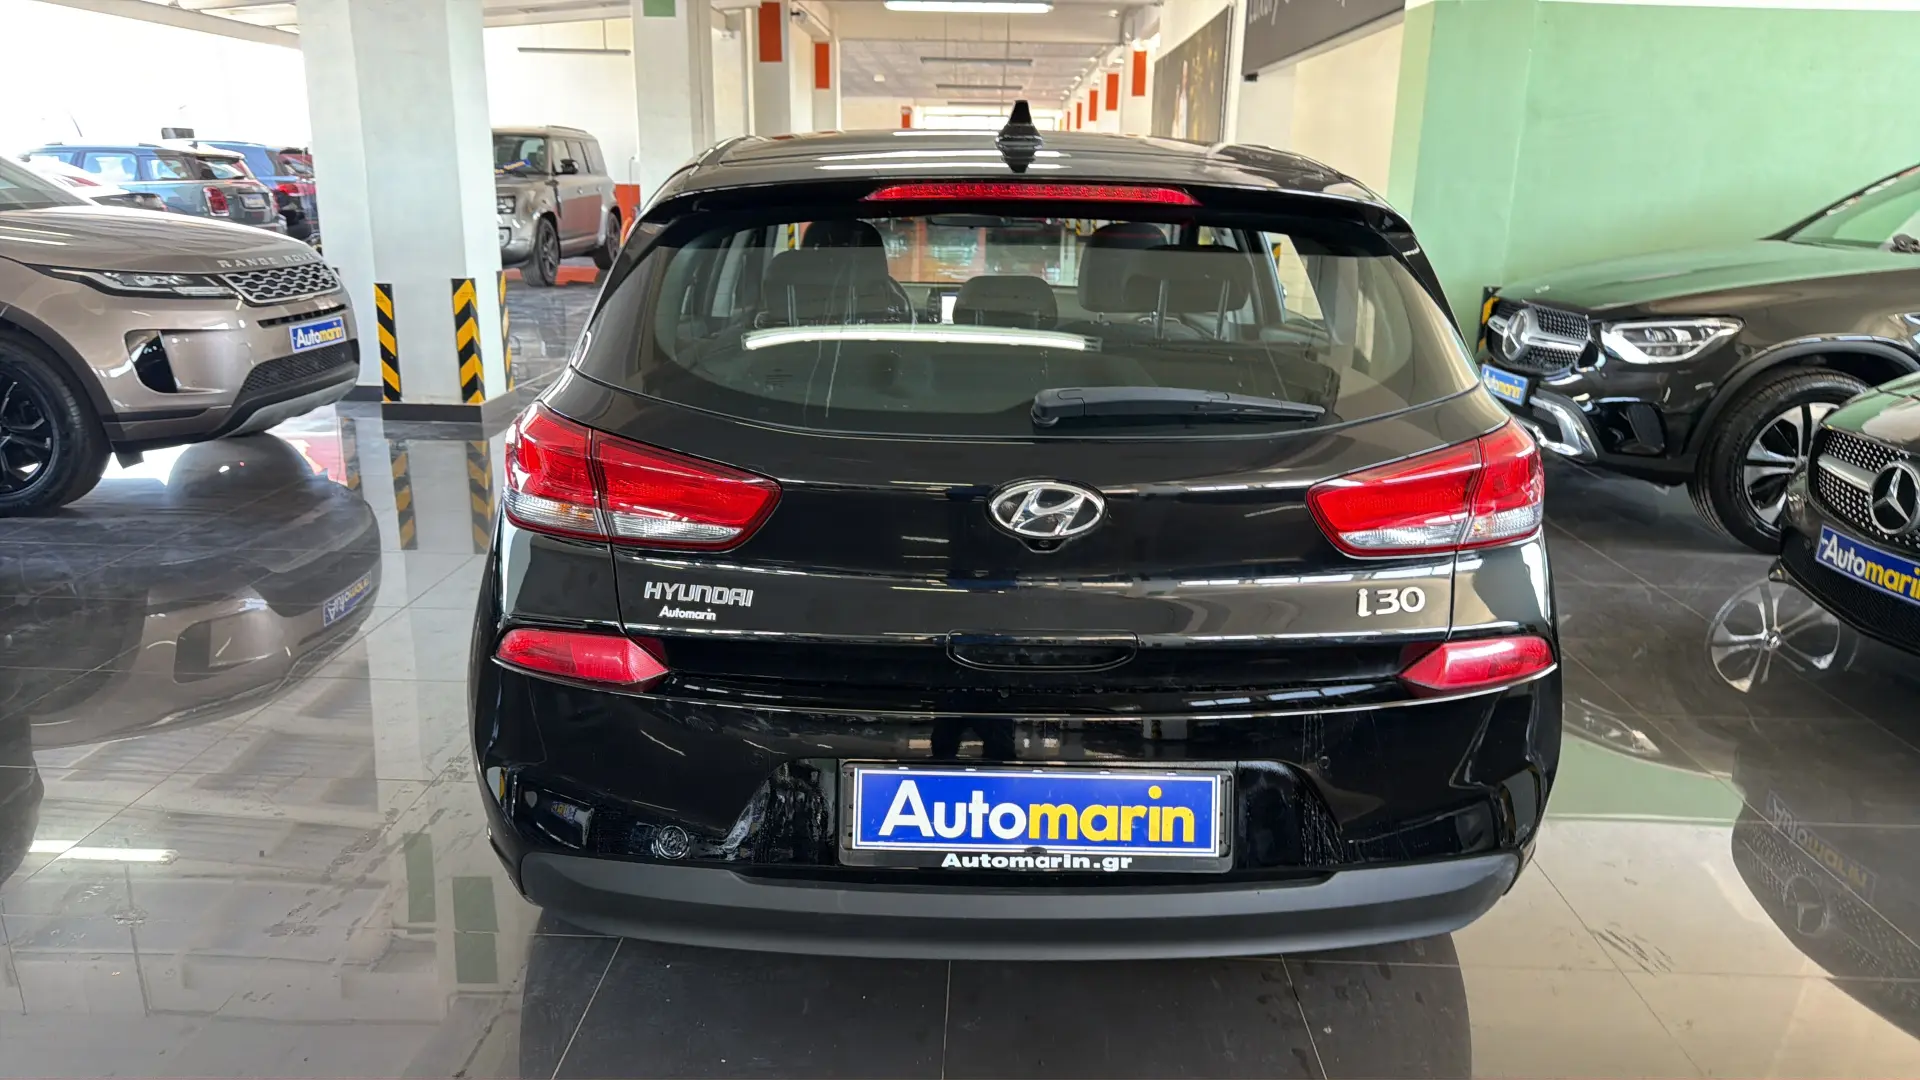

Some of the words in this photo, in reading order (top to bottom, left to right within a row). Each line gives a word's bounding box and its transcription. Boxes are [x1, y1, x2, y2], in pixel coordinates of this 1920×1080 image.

[283, 251, 315, 265] ROVE
[1822, 534, 1920, 600] Automari
[643, 581, 754, 607] HYUNDAI
[658, 605, 717, 621] Automarin
[878, 779, 1195, 843] Automarin
[941, 853, 1133, 872] Automarin.gr
